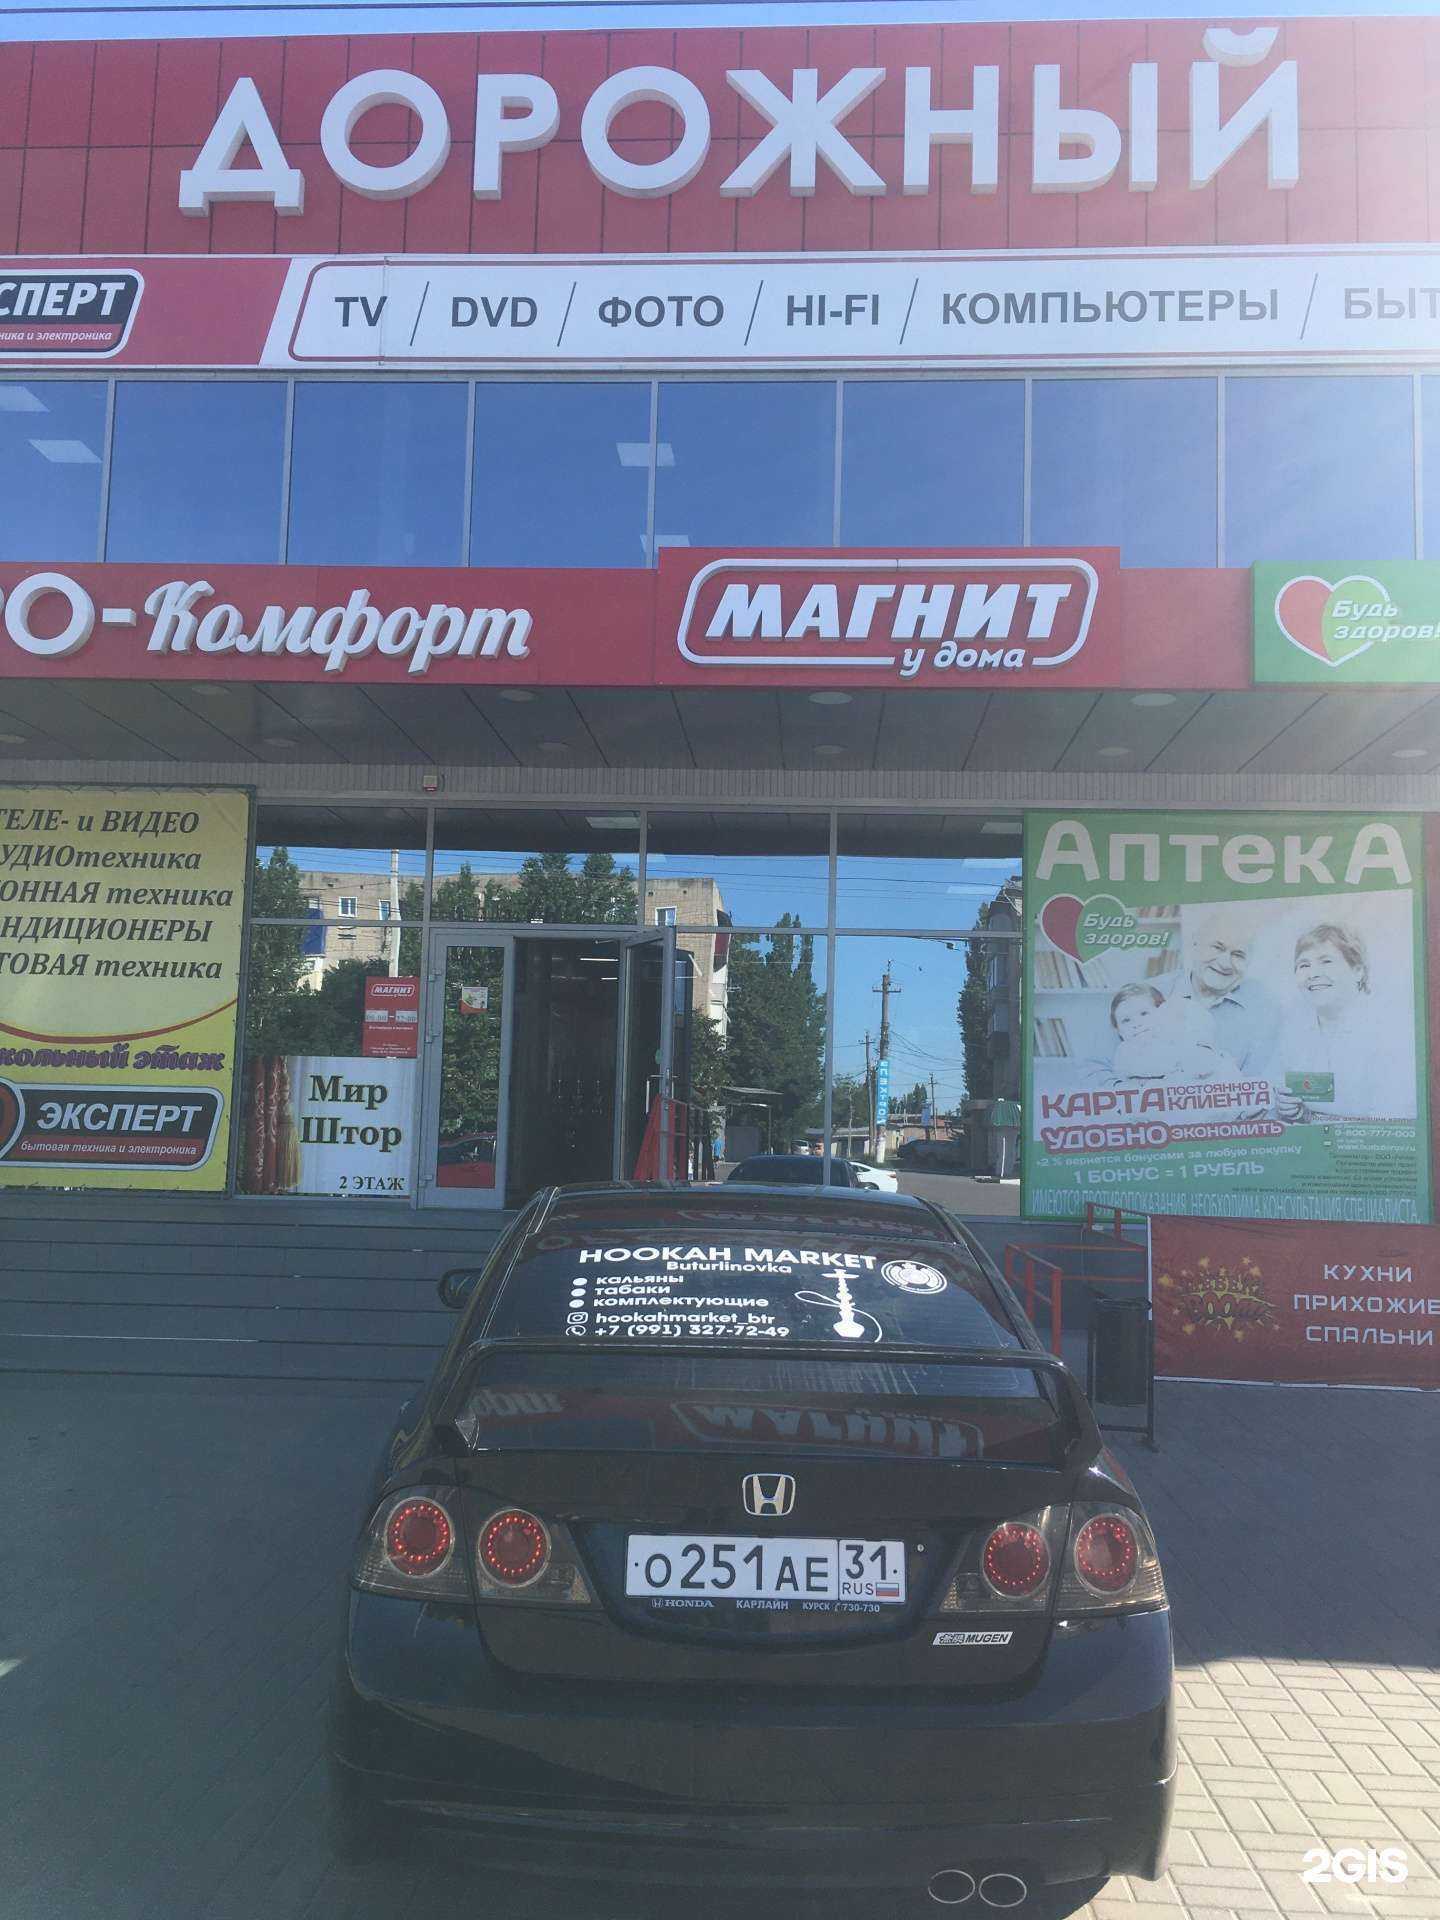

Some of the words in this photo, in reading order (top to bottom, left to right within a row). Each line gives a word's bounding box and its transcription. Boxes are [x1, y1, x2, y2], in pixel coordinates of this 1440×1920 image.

[178, 27, 1300, 217] ДОРОЖНЫЙ
[335, 296, 387, 328] TV
[451, 295, 538, 328] DVD
[598, 294, 724, 328] ФОТО
[786, 293, 880, 327] HI-FI
[943, 288, 1278, 326] КОМПЬЮТЕРЫ
[1344, 288, 1440, 319] БЫТ
[27, 332, 34, 341] и
[36, 331, 112, 343] электроника
[706, 584, 1072, 640] МАГНИТ
[1332, 600, 1399, 621] Будь
[0, 572, 533, 676] О-Комфорт
[900, 644, 925, 677] у
[932, 641, 1024, 670] дома
[77, 816, 94, 832] и
[101, 810, 200, 838] ВИДЕО
[0, 880, 101, 903] ОННАЯ
[106, 887, 234, 907] техника
[1083, 913, 1135, 930] Будь
[1084, 931, 1169, 949] здоров!
[94, 959, 222, 979] техника
[373, 986, 413, 994] МАГНИТ
[133, 1044, 226, 1071] этаж
[308, 1075, 388, 1110] Мир
[1167, 1080, 1269, 1096] ПОСТОЯННОГО
[1041, 1087, 1166, 1119] КАРТА
[1168, 1091, 1271, 1110] КЛИЕНТА
[37, 1102, 202, 1133] ЭКСПЕРТ
[300, 1116, 402, 1152] Штор
[1045, 1126, 1167, 1149] УДОБНО
[1171, 1122, 1282, 1140] ЭКОНОМИТЬ
[21, 1140, 69, 1152] бытовая
[72, 1142, 116, 1154] техника
[119, 1144, 126, 1154] и
[128, 1144, 197, 1156] электроника
[1124, 1150, 1184, 1163] бонусами
[1188, 1150, 1202, 1159] за
[1206, 1146, 1248, 1159] любую
[1251, 1144, 1302, 1157] покупку
[339, 1175, 348, 1189] 2
[352, 1176, 404, 1190] ЭТАЖ
[1074, 1170, 1082, 1184] 1
[1088, 1166, 1160, 1183] БОНУС
[1179, 1164, 1187, 1179] 1
[1193, 1161, 1265, 1178] РУБЛЬ
[579, 1247, 731, 1264] HOOKAH
[744, 1248, 877, 1270] MARKET
[666, 1261, 792, 1274] Buturlinovka
[596, 1275, 684, 1285] кальяны
[1323, 1264, 1412, 1282] КУХНИ
[595, 1285, 671, 1295] табаки
[593, 1296, 769, 1309] комплектующие
[1293, 1294, 1440, 1315] ПРИХОЖИЕ
[595, 1312, 775, 1325] hookahmarket_btr
[595, 1325, 620, 1337] +7
[628, 1324, 682, 1338] (991)
[689, 1325, 790, 1338] 327-72-49
[1306, 1325, 1433, 1346] СПАЛЬНИ
[845, 1544, 887, 1580] 31
[842, 1582, 874, 1596] RUS
[664, 1600, 715, 1608] HONDA
[736, 1600, 789, 1610] КАРЛАЙН
[802, 1602, 830, 1611] КУРСК
[843, 1603, 881, 1612] 730-730
[966, 1633, 1009, 1643] MUGEN
